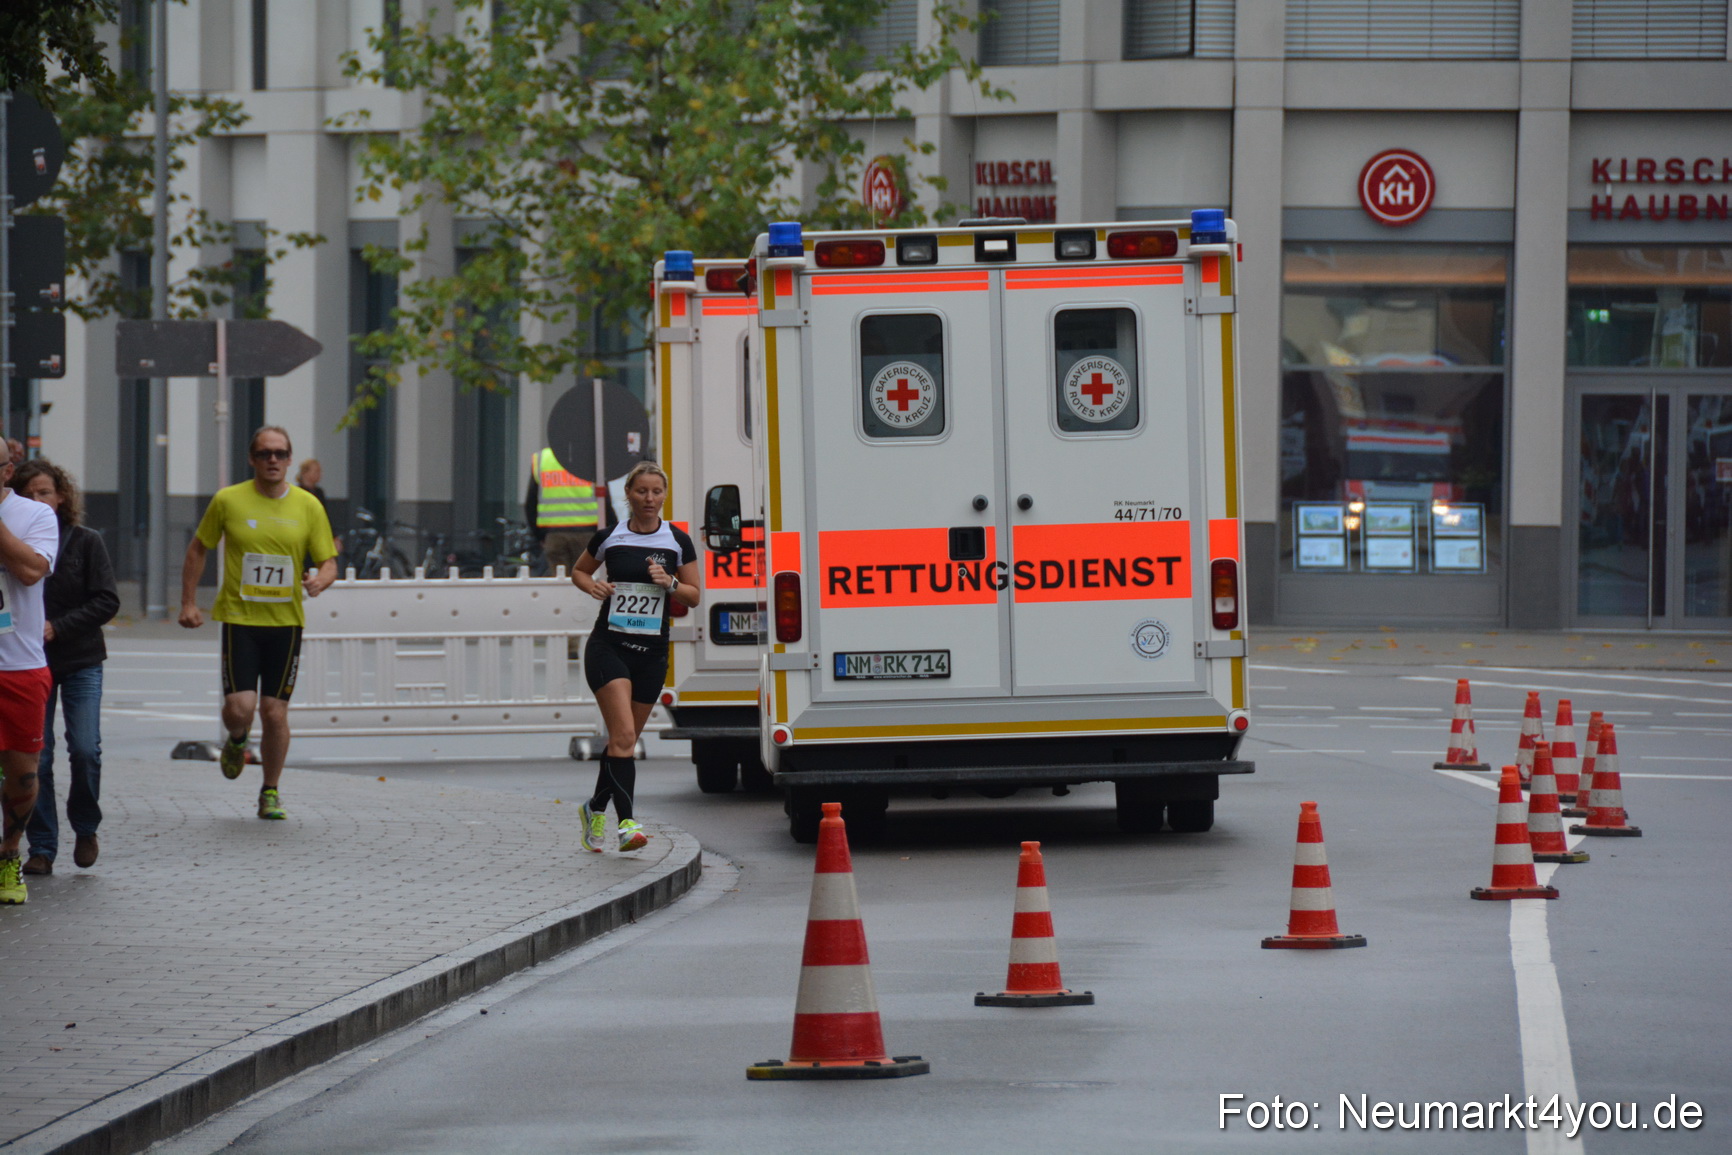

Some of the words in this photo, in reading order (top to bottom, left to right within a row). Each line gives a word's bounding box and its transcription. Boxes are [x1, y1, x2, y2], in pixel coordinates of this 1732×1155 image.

[976, 160, 1052, 187] KIRSCH
[1378, 182, 1415, 205] KH
[1590, 194, 1728, 221] HAUBN
[875, 366, 931, 393] BAYERISCHES
[1069, 360, 1125, 387] BAYERISCHES
[875, 397, 901, 423] ROTES
[905, 396, 931, 423] KREUZ
[1069, 391, 1095, 418] ROTES
[1099, 390, 1126, 417] KREUZ
[1114, 507, 1182, 522] 44/71/70
[253, 566, 284, 585] 171
[828, 556, 1182, 596] RETTUNGSDIENST
[616, 594, 661, 615] 2227
[627, 618, 645, 627] Kathi
[730, 614, 751, 630] NM
[847, 656, 871, 674] NM
[884, 655, 908, 673] RK
[912, 654, 946, 673] 714
